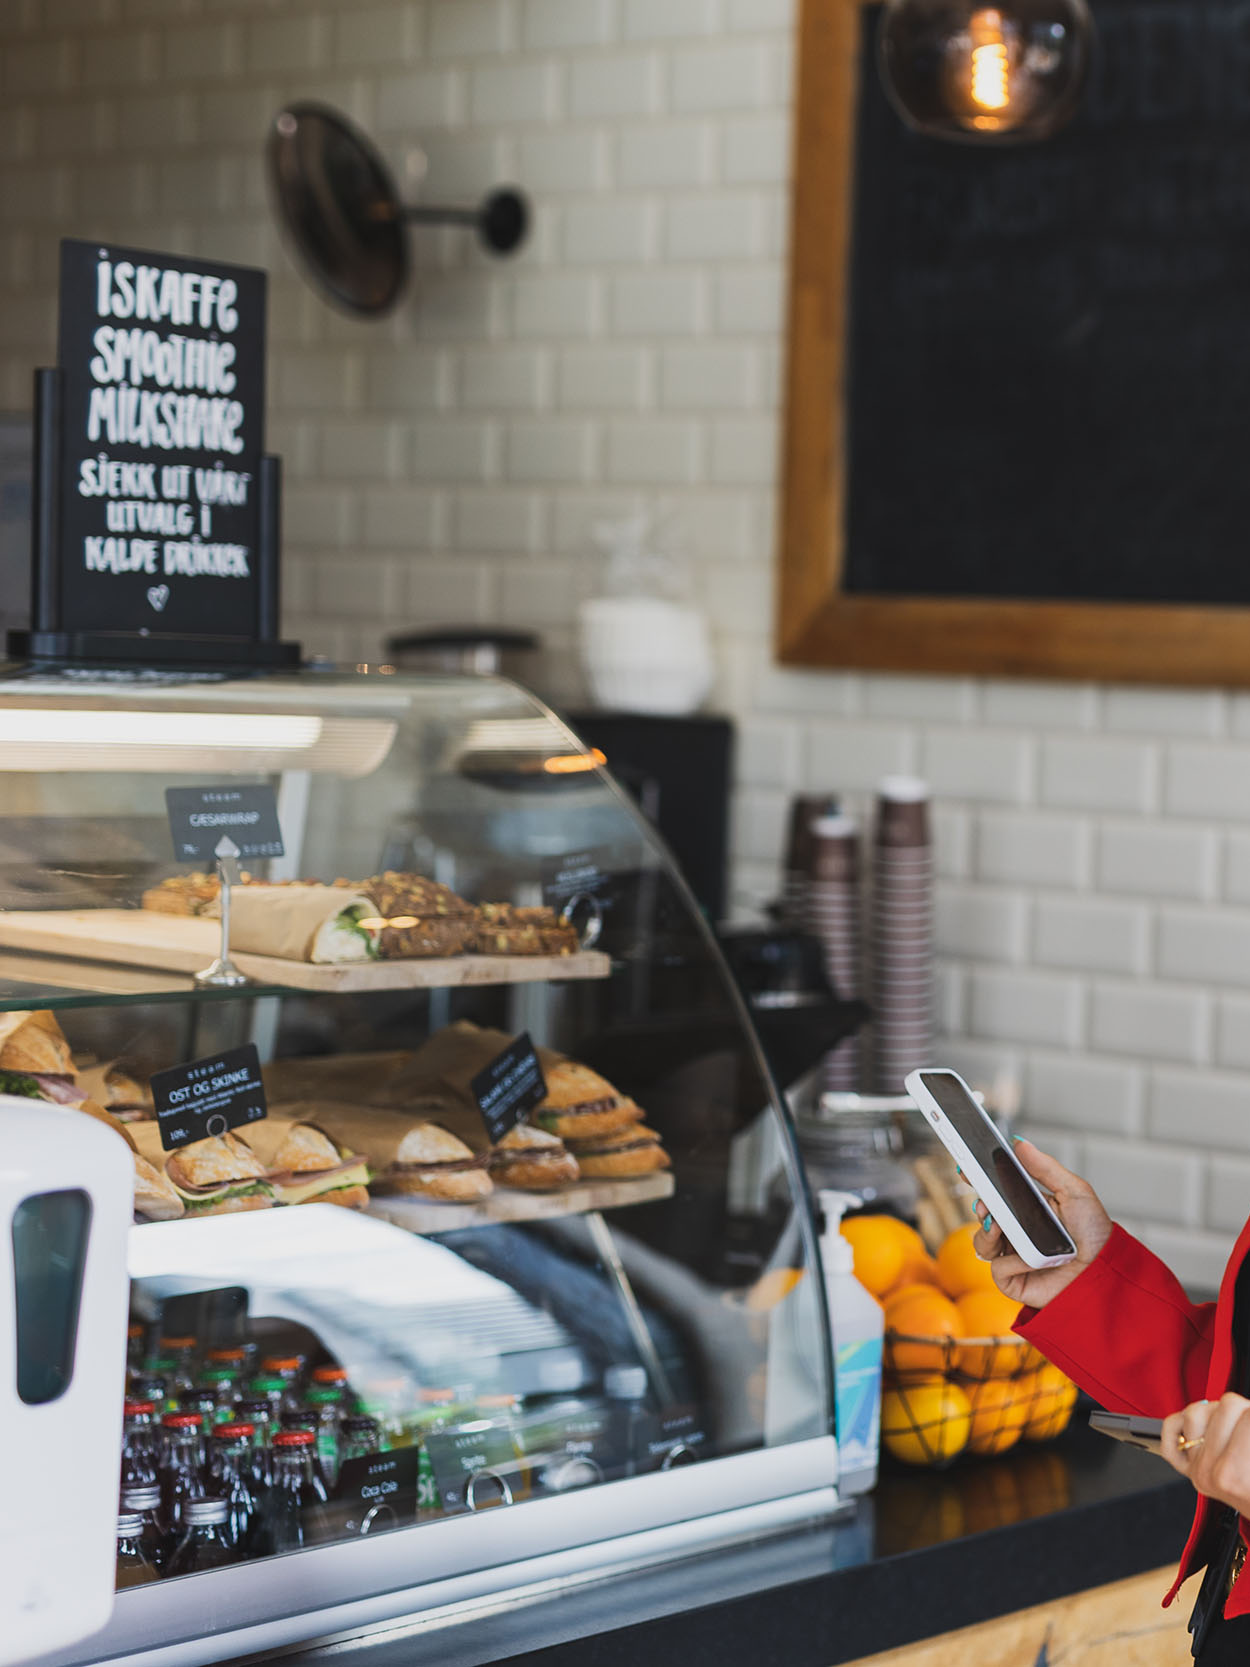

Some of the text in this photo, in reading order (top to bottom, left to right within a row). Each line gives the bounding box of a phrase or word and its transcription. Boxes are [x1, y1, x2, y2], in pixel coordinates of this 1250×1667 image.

[88, 380, 245, 455] MILKSHAKE
[79, 452, 157, 499] SJEKK
[161, 465, 192, 499] UT
[106, 500, 195, 535] UTVALG
[84, 536, 159, 575] KALDE
[169, 1085, 191, 1103] OST
[192, 1080, 211, 1096] OG
[211, 1067, 250, 1091] SKINKE
[361, 1485, 380, 1499] Coca
[381, 1480, 400, 1495] Cola
